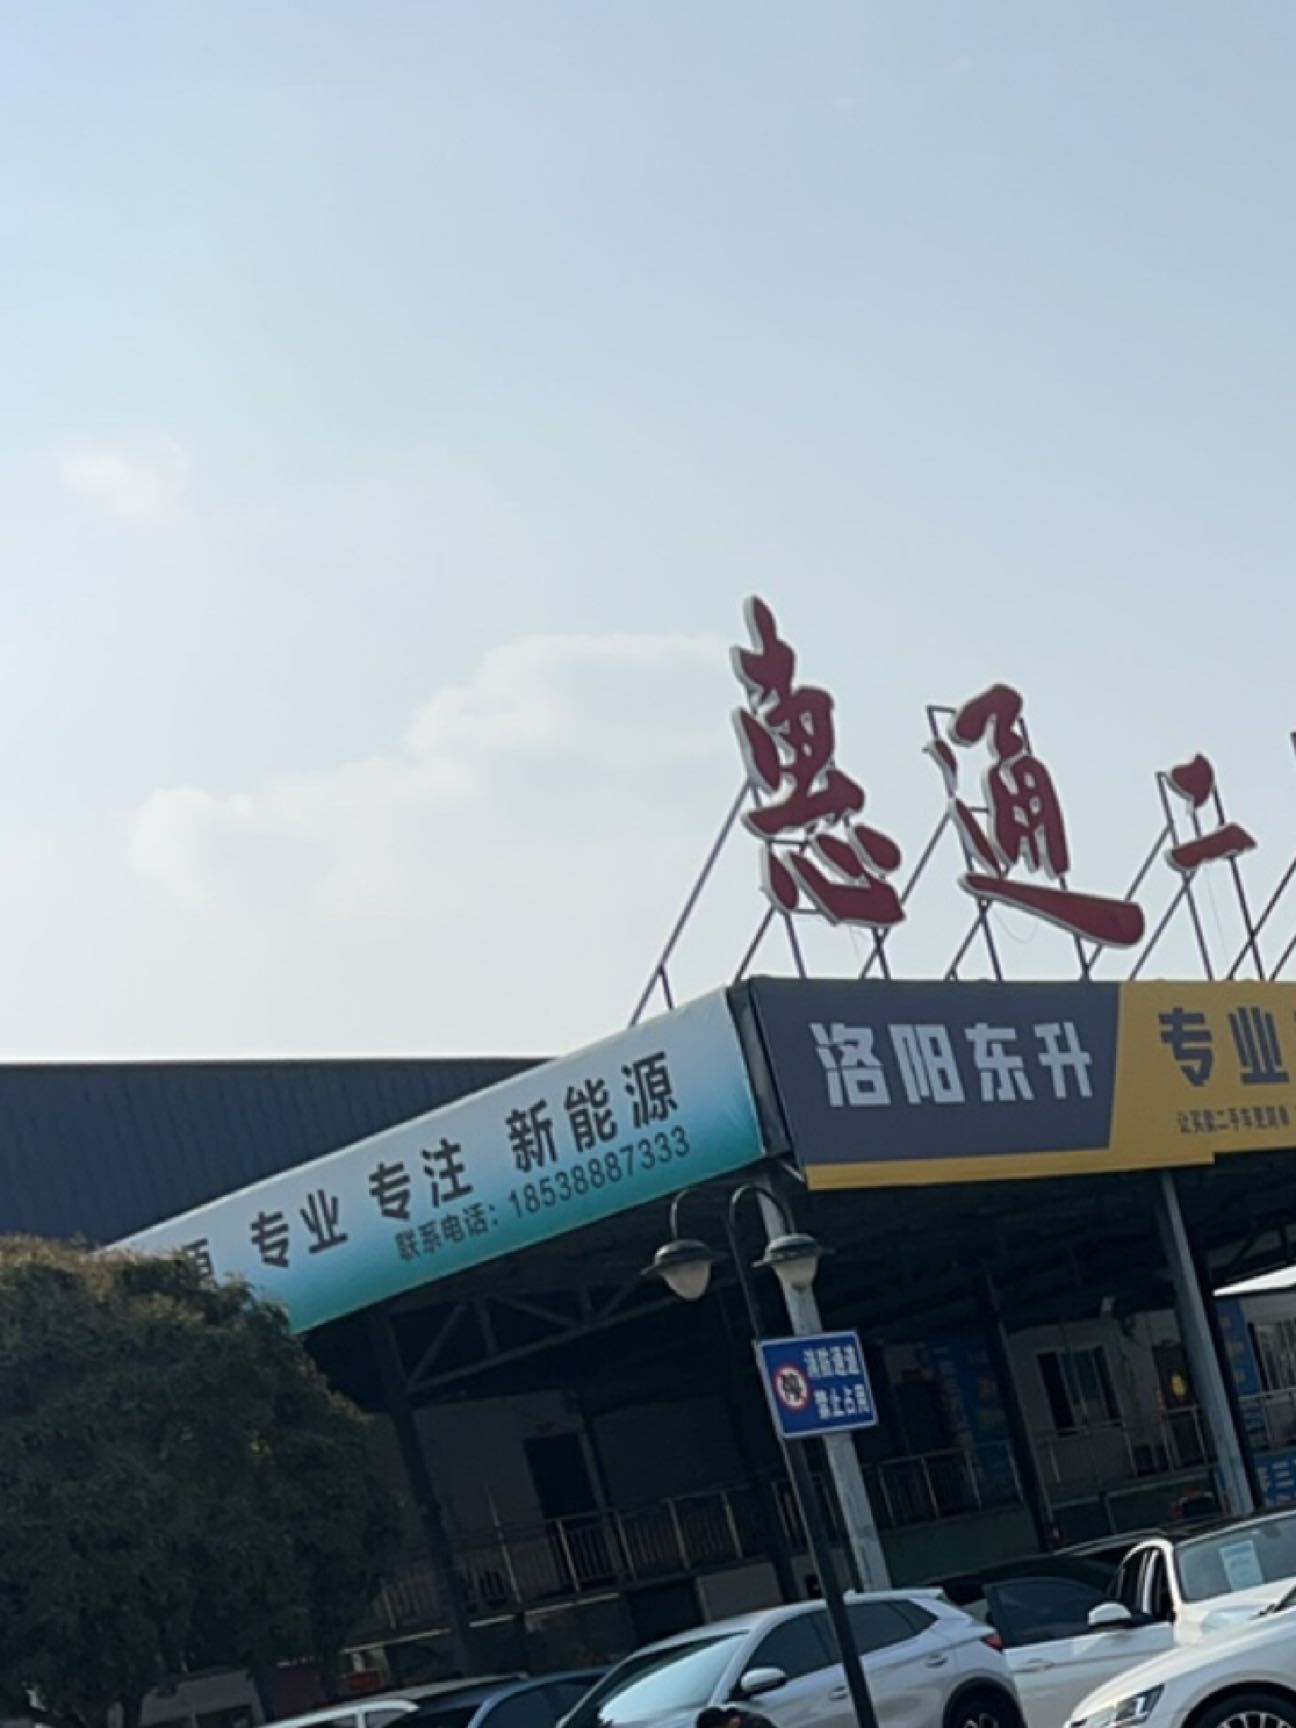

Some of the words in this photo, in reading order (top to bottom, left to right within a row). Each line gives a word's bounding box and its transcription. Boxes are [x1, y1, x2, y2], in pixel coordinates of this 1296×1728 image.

[809, 1022, 1092, 1107] 洛阳东升
[250, 1189, 349, 1268] 专业
[369, 1137, 473, 1220] 专注
[505, 1050, 678, 1173] 新能源
